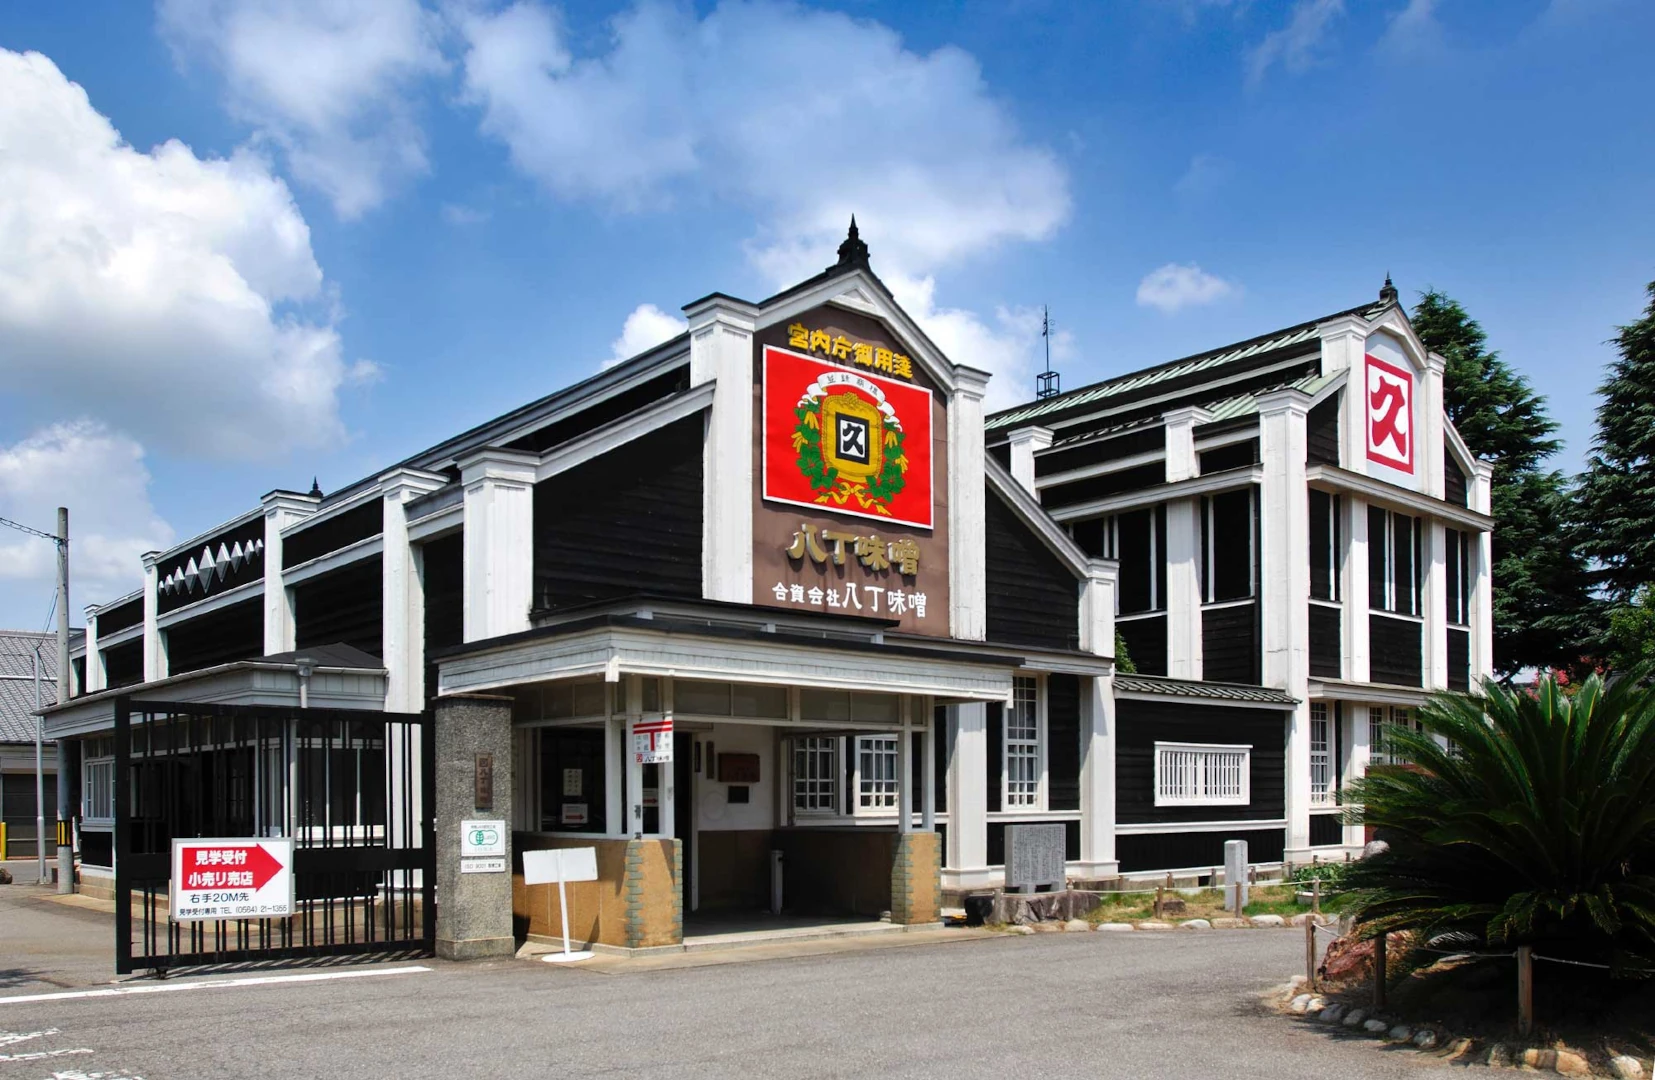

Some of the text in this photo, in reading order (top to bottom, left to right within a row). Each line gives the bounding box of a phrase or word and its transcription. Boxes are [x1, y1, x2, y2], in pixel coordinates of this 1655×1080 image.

[787, 322, 913, 379] 宮内庁御用達
[841, 422, 866, 457] 久
[785, 523, 920, 576] 八丁味噌
[195, 850, 247, 865] 見学受付
[188, 871, 253, 886] 小売り売店
[190, 892, 249, 904] 右手20M先
[220, 906, 232, 914] TEL
